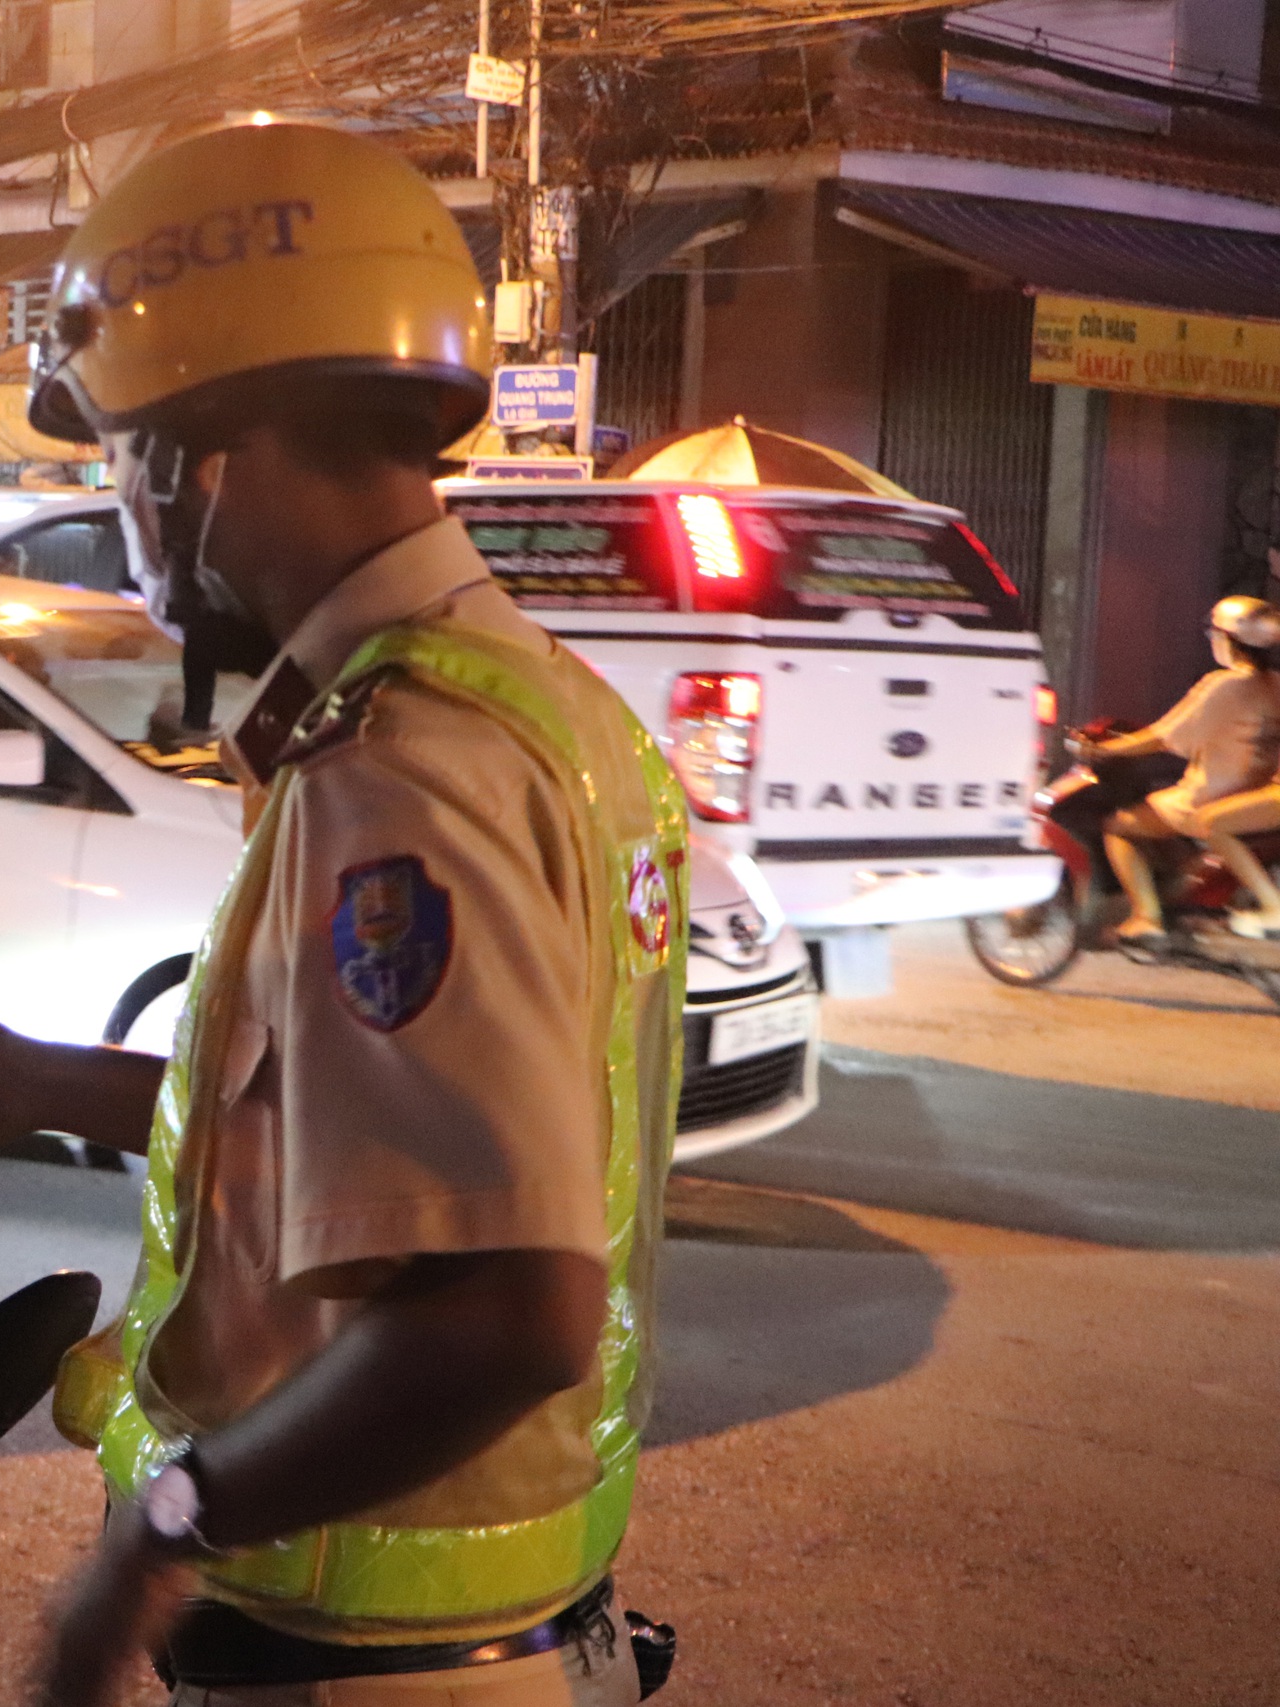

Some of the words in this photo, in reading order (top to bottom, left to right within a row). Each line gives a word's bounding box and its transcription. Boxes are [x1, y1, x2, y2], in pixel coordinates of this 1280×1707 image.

[99, 199, 314, 309] CSGT
[499, 391, 536, 407] QUANG
[538, 390, 574, 406] TRUNG
[764, 780, 1023, 809] RANGER
